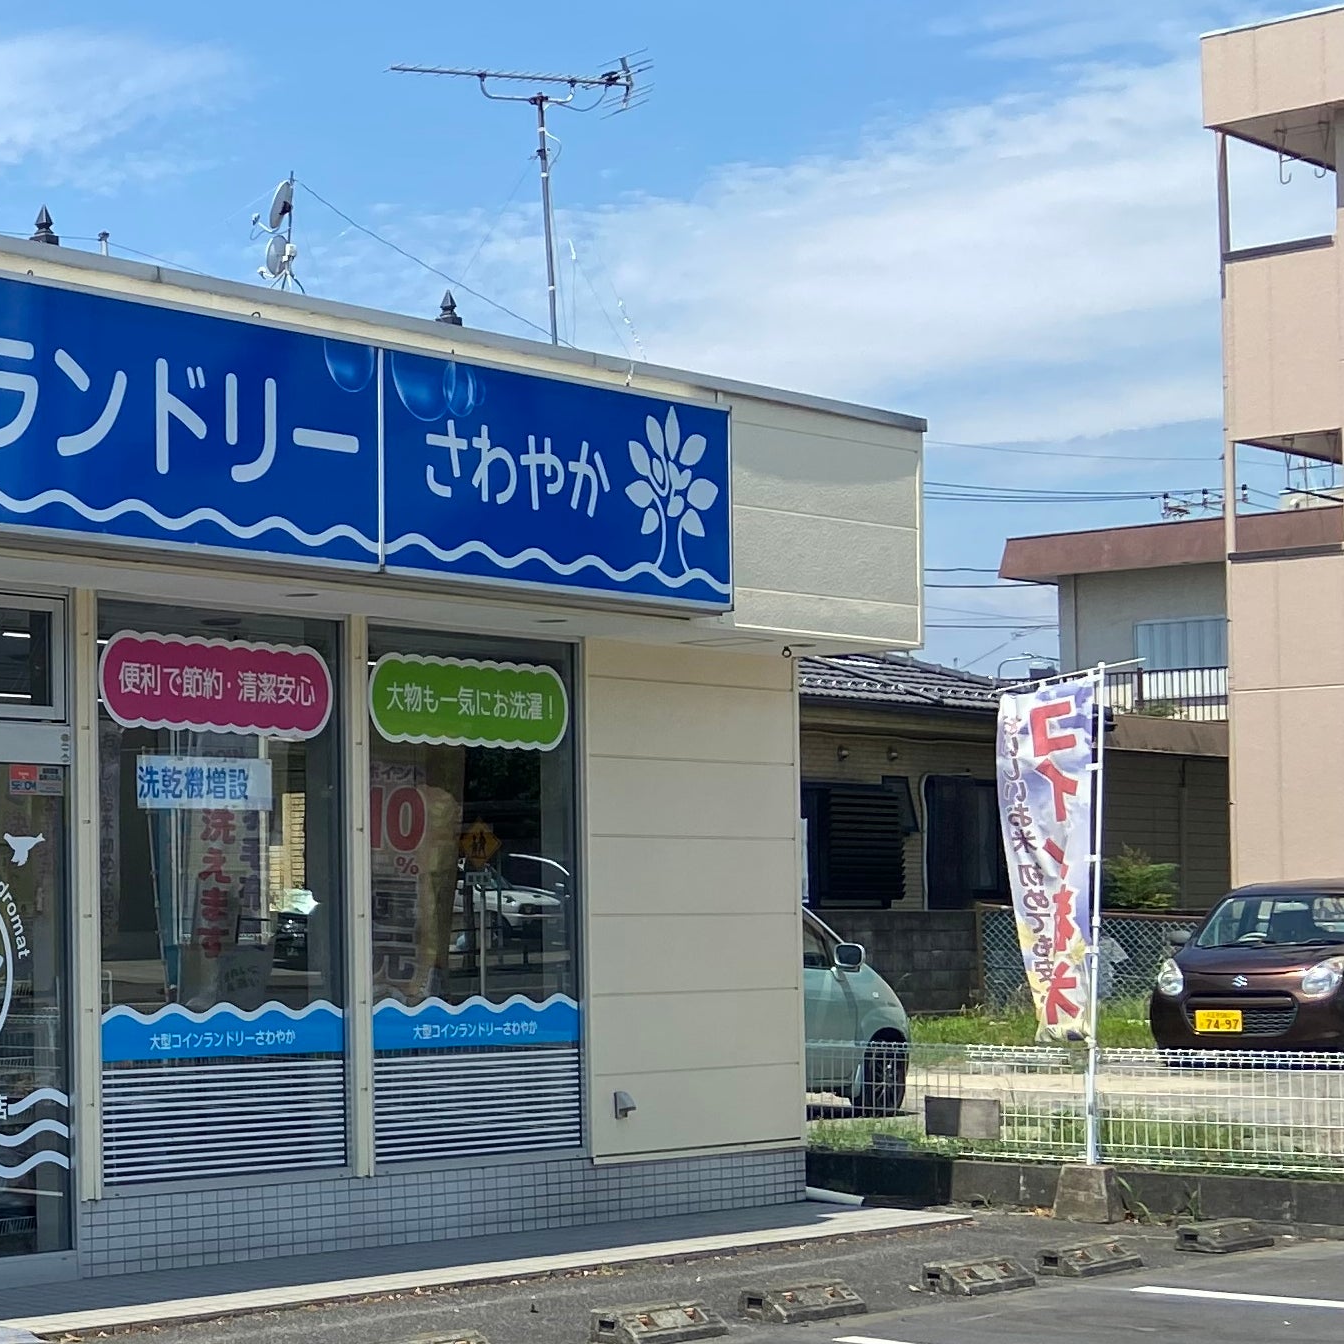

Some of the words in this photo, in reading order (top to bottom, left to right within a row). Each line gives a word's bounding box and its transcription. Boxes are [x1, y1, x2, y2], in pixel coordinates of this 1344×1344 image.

[423, 414, 612, 519] さわやか
[118, 660, 316, 706] 便利で節約・清潔安心
[149, 1028, 296, 1050] 大型コインランドリーさわやか
[413, 1021, 538, 1040] 大型コインランドリーさわやか
